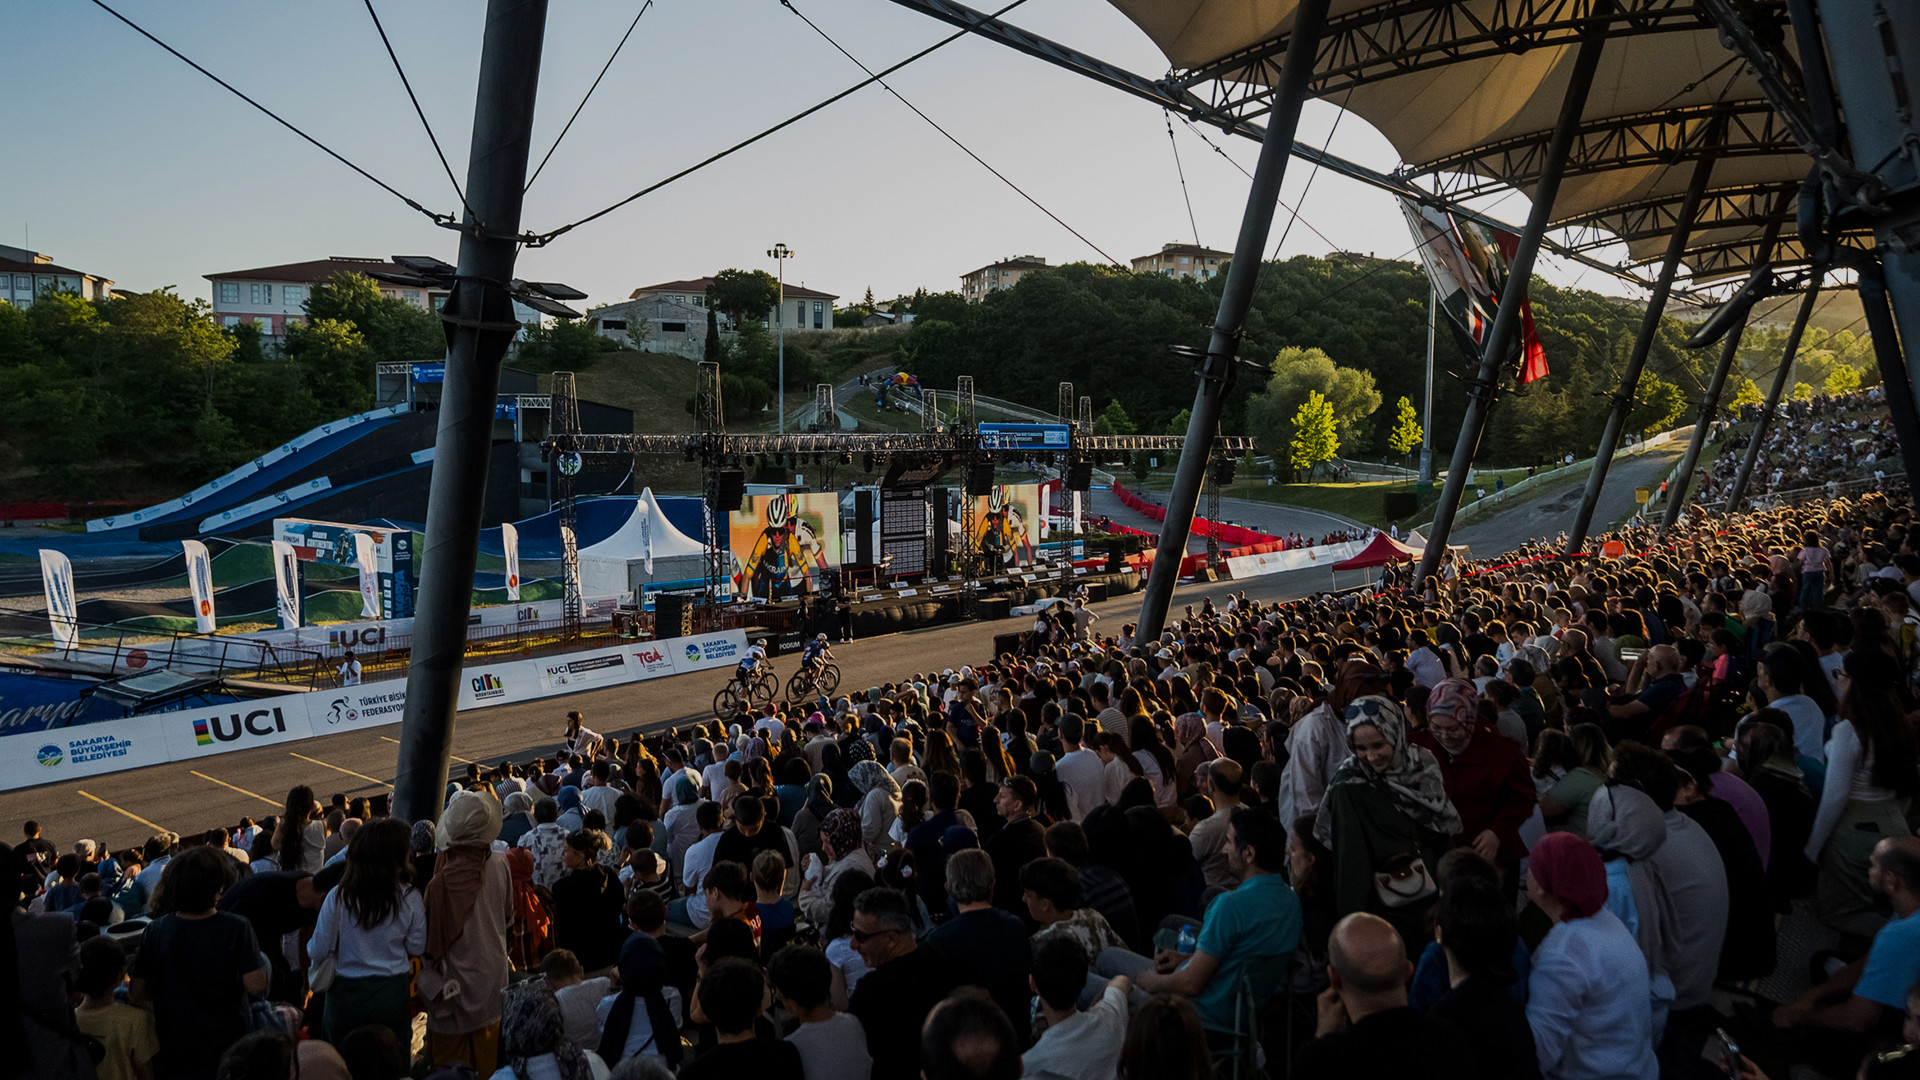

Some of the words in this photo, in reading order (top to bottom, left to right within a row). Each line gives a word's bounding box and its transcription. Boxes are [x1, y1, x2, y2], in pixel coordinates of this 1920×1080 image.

[340, 627, 386, 647] UCI
[702, 639, 728, 648] SAKARYA
[779, 641, 800, 650] PODIUM
[632, 646, 664, 668] TGA
[550, 665, 568, 674] UCI
[472, 674, 503, 692] CITY
[359, 694, 388, 706] TÜRKİYE
[388, 691, 406, 702] BİSİK
[0, 697, 86, 729] arya
[362, 703, 406, 717] FEDERASYON
[210, 707, 286, 742] UCI
[69, 736, 115, 748] SAKARYA
[70, 740, 132, 756] BÜYÜKŞEHİR
[72, 748, 127, 764] BELEDİYESİ
